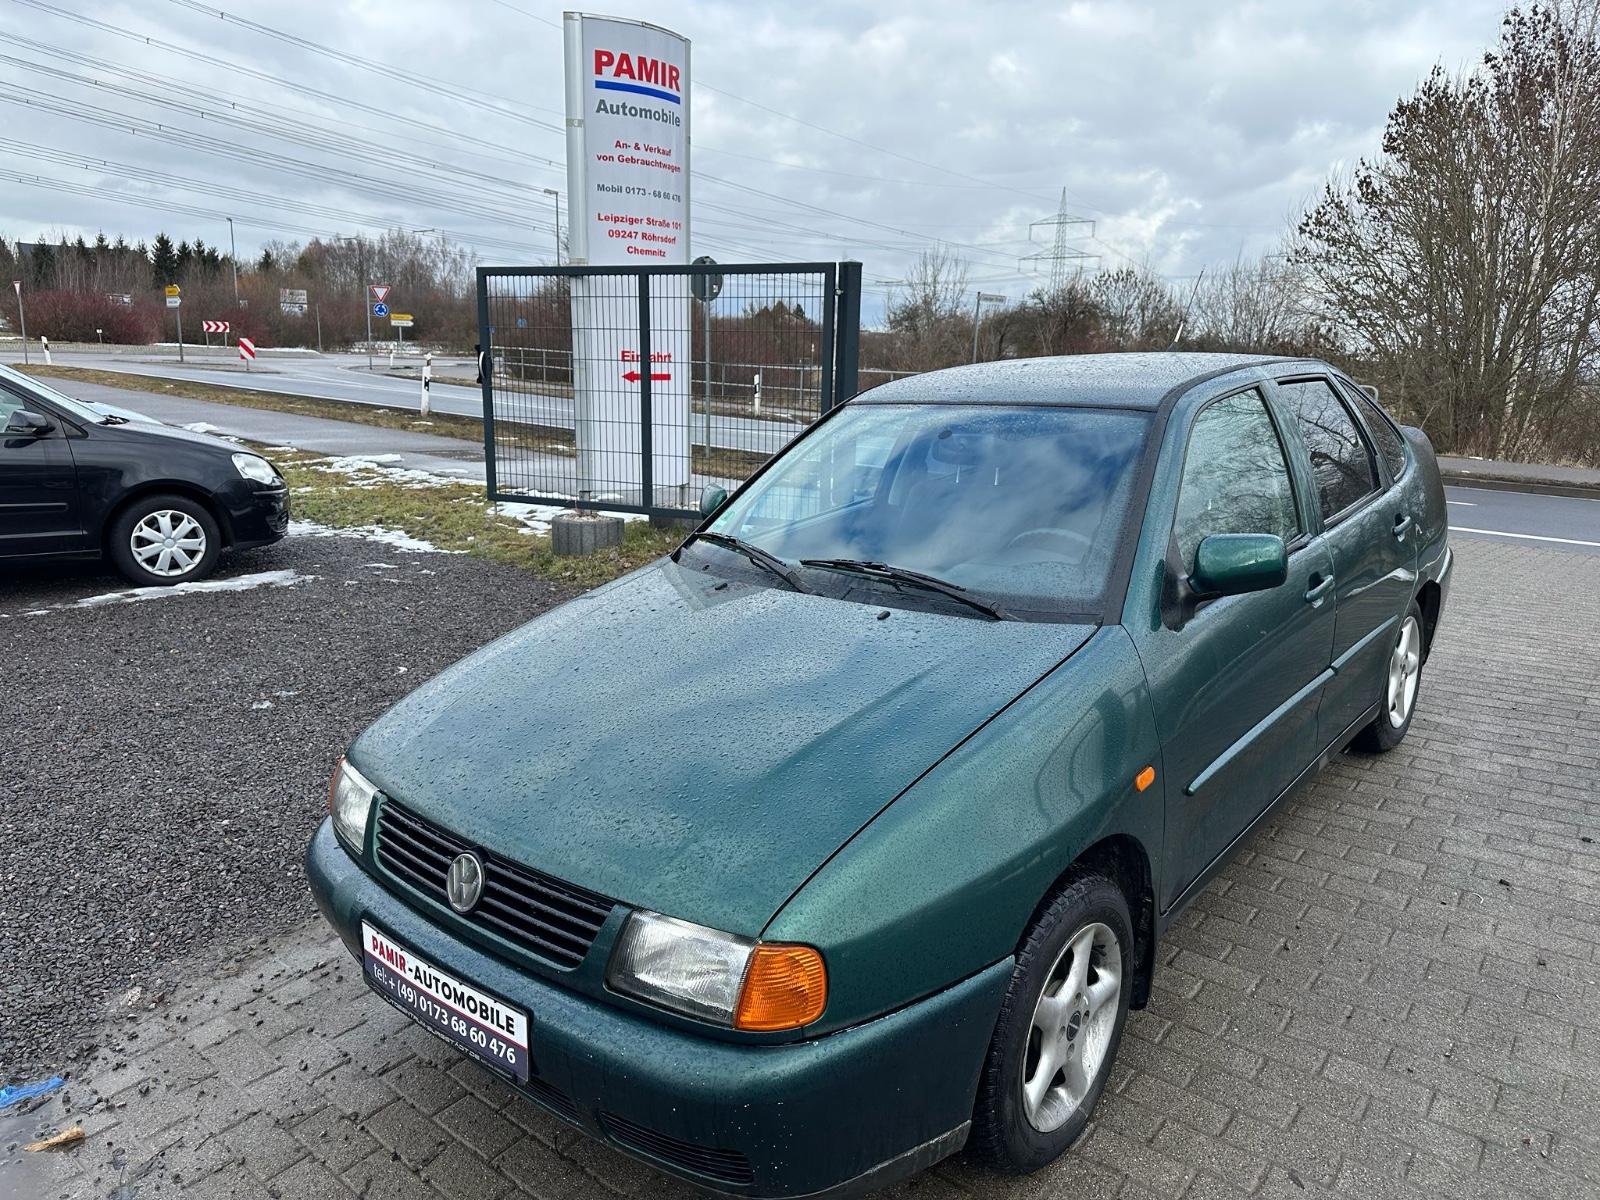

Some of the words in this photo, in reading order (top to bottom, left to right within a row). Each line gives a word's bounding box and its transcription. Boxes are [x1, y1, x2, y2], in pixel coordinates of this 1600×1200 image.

[594, 49, 681, 93] PAMIR
[596, 98, 681, 127] Automobile
[615, 140, 631, 149] An-
[634, 142, 641, 151] &
[643, 144, 672, 156] Verkauf
[597, 154, 615, 162] von
[617, 154, 681, 173] Gebrauchtwagen
[597, 183, 623, 193] Mobil
[625, 186, 646, 196] 0173
[653, 190, 662, 198] 68
[663, 191, 671, 200] 60
[597, 213, 644, 225] Leipziger
[646, 217, 671, 228] Straße
[672, 221, 682, 230] 101
[608, 229, 639, 240] 09247
[641, 232, 677, 245] Röhrsdorf
[627, 245, 667, 258] Chemnitz
[621, 350, 672, 363] Einahrt
[398, 980, 417, 1008] (49)
[419, 995, 448, 1026] 0173
[451, 1016, 467, 1037] 68
[469, 1027, 487, 1048] 60
[489, 1038, 516, 1064] 476
